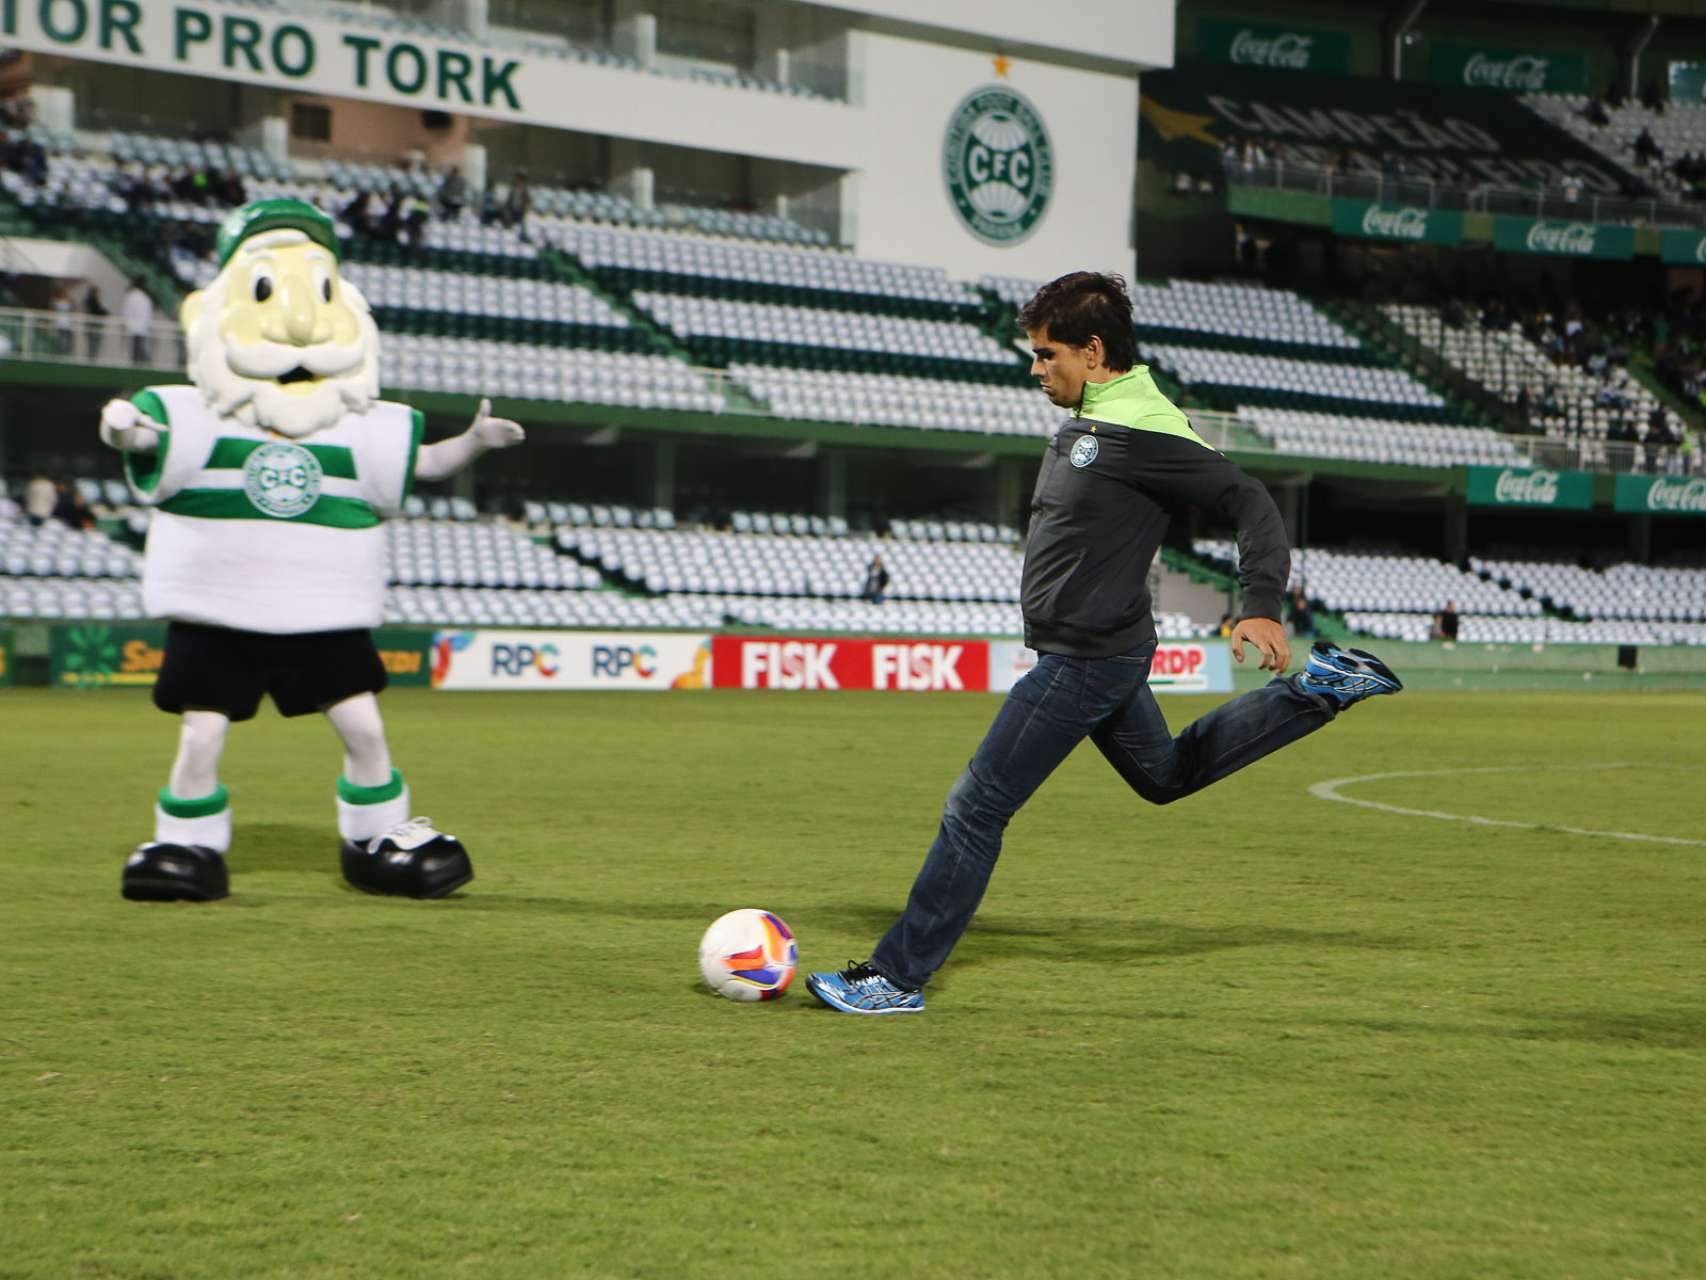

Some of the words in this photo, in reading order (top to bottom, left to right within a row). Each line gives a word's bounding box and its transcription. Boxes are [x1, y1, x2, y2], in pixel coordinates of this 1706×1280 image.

[175, 9, 315, 78] PRO
[342, 35, 523, 110] TORK
[969, 145, 1030, 189] CFC
[492, 643, 561, 678] RPC
[593, 645, 657, 679] RPC
[741, 641, 839, 690] FISK
[872, 643, 964, 691] FISK
